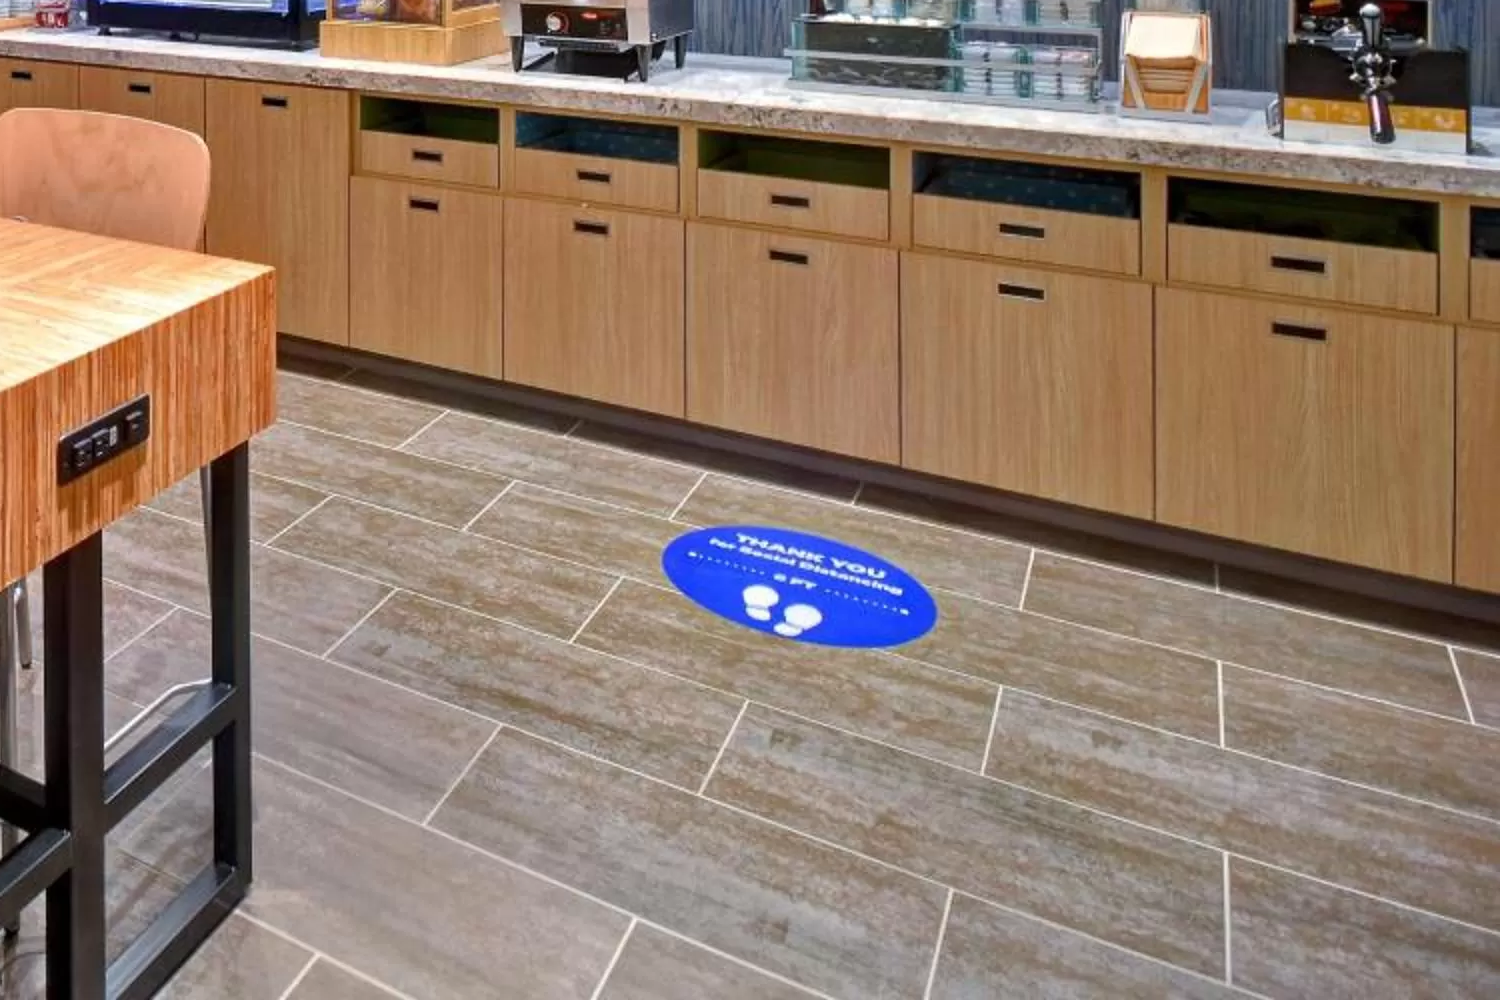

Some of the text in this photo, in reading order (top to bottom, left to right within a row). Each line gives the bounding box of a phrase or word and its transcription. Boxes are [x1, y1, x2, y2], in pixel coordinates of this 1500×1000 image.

[736, 532, 888, 580] THANK YOU
[739, 545, 797, 567] Social
[799, 559, 904, 597] Distancing
